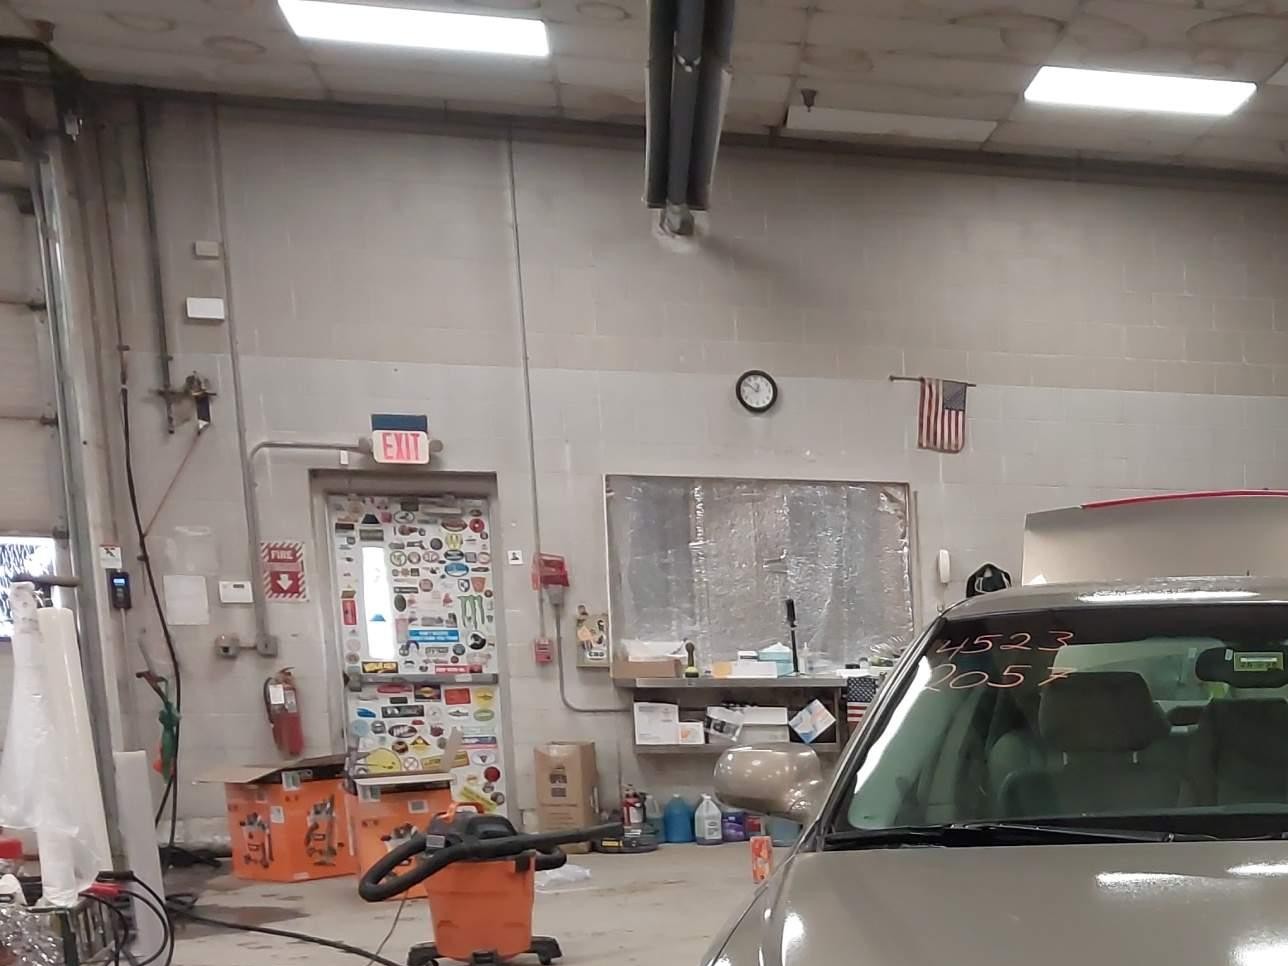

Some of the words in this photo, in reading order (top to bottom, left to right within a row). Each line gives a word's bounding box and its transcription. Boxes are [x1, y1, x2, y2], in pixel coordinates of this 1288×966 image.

[382, 432, 421, 460] EXIT
[270, 549, 294, 560] FIRE
[936, 630, 1074, 661] 4523
[926, 663, 1076, 692] 2057
